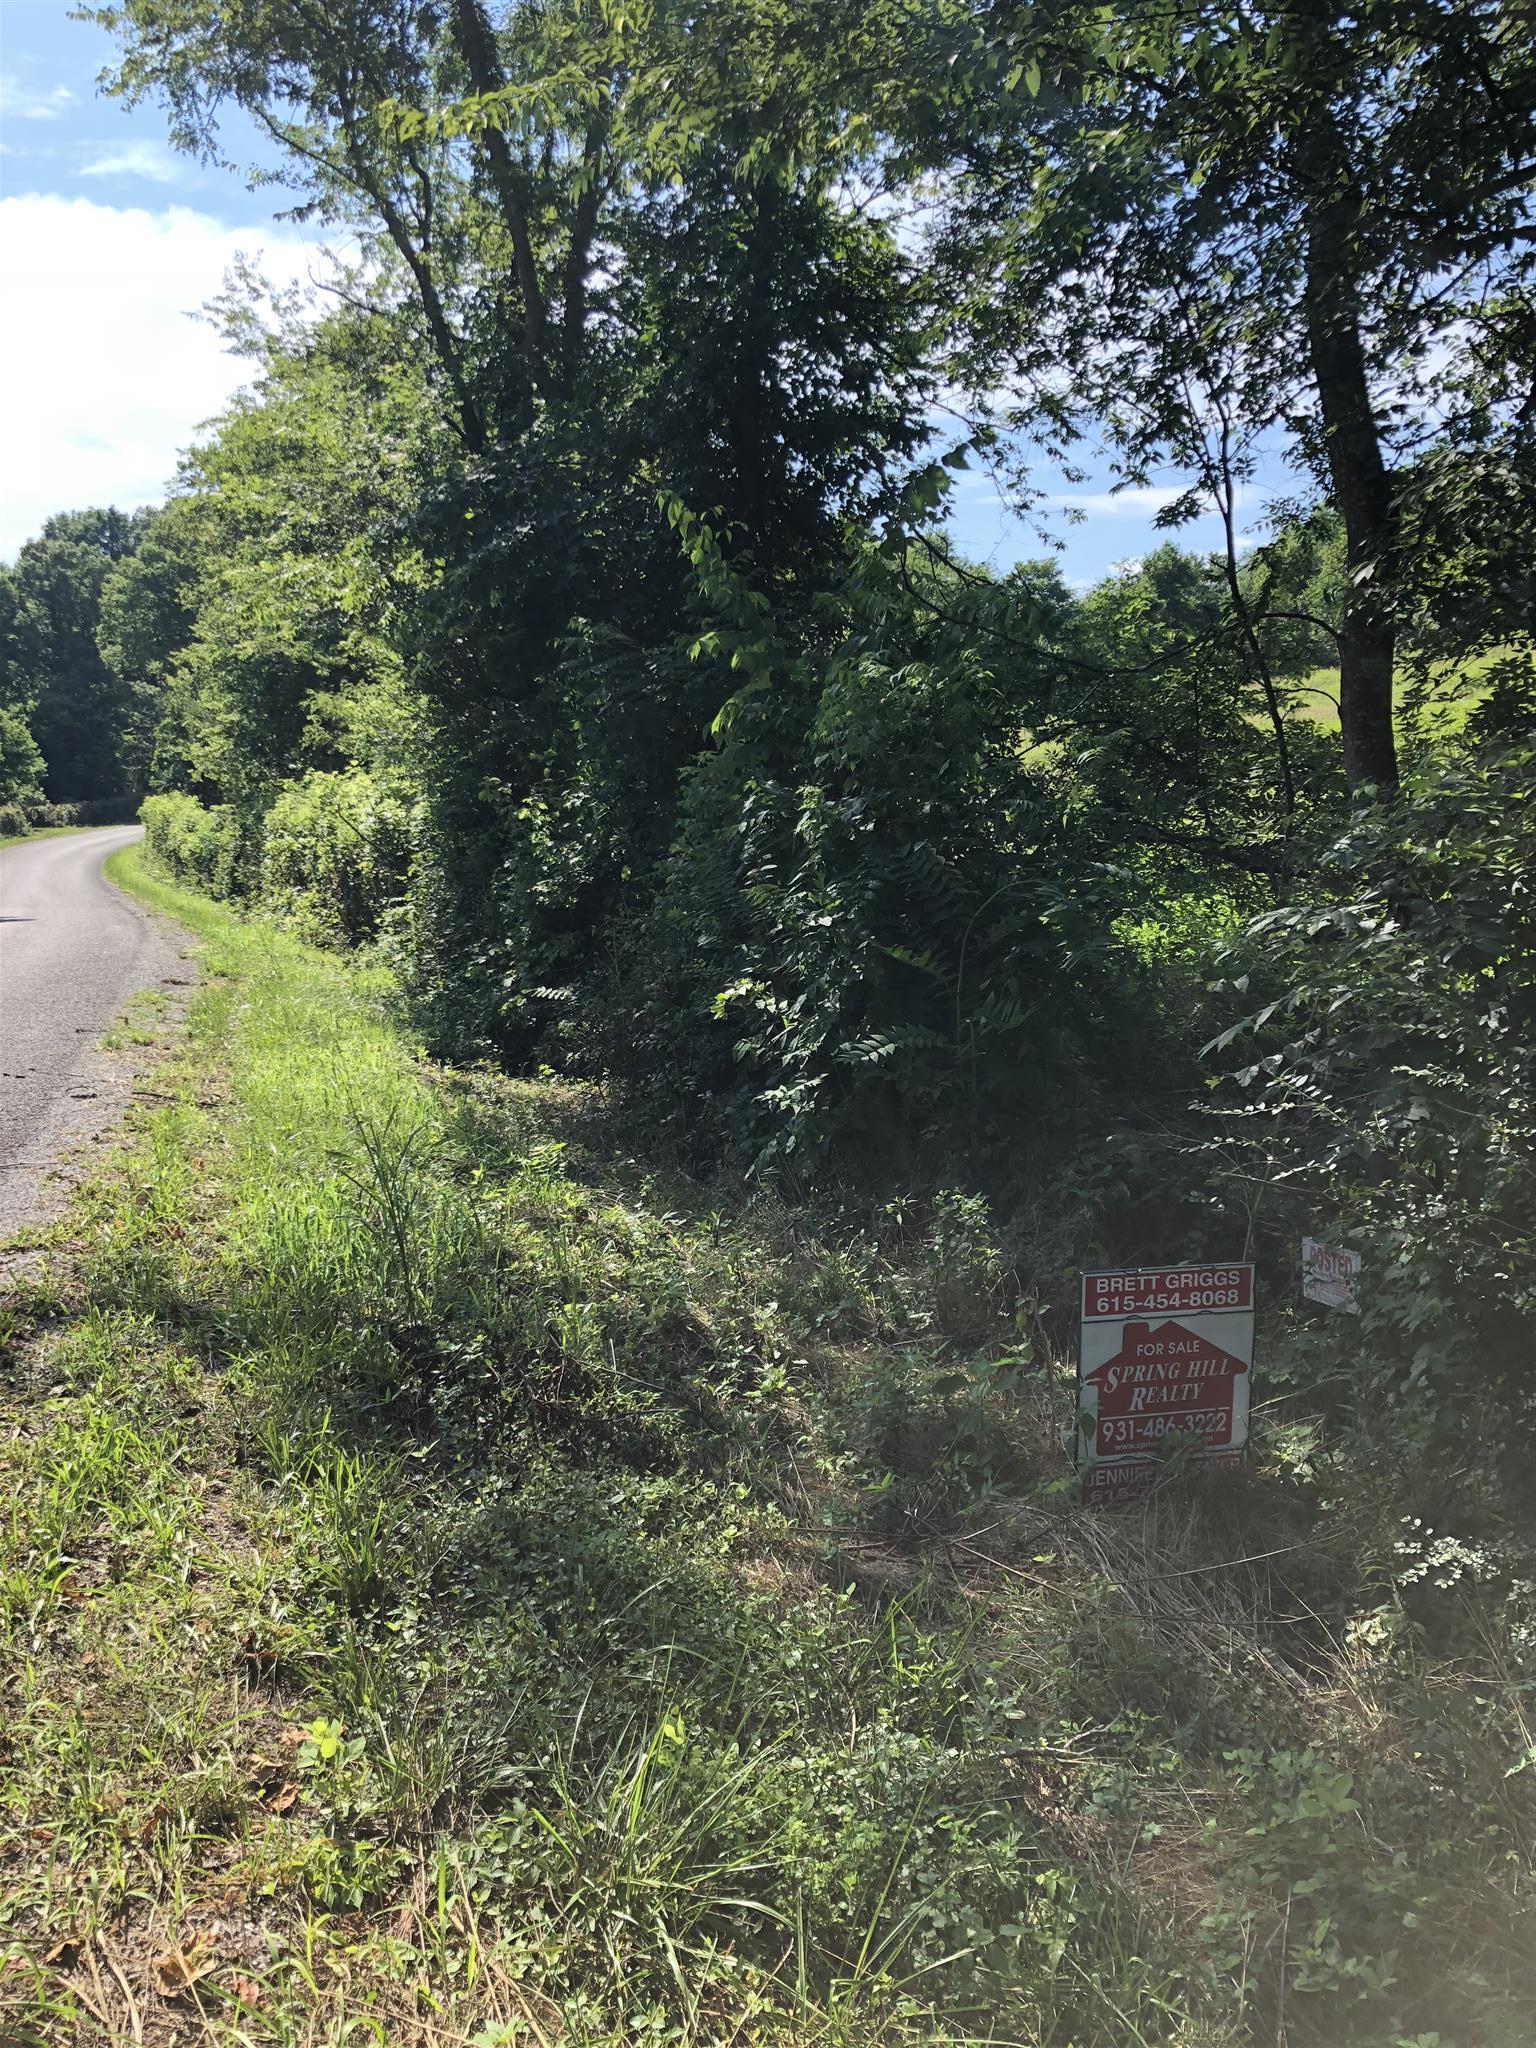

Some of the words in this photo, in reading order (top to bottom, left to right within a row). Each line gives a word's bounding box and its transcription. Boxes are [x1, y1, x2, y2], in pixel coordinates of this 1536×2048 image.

[1096, 1276, 1161, 1293] BRETT
[1165, 1270, 1240, 1289] GRIGGS
[1096, 1289, 1239, 1313] 615-454-8068
[1136, 1343, 1164, 1356] FOR
[1168, 1340, 1200, 1355] SALE
[1103, 1361, 1181, 1394] SPRING
[1185, 1358, 1230, 1378] HILL
[1128, 1382, 1205, 1412] REALTY
[1102, 1411, 1227, 1443] 931-486-3222
